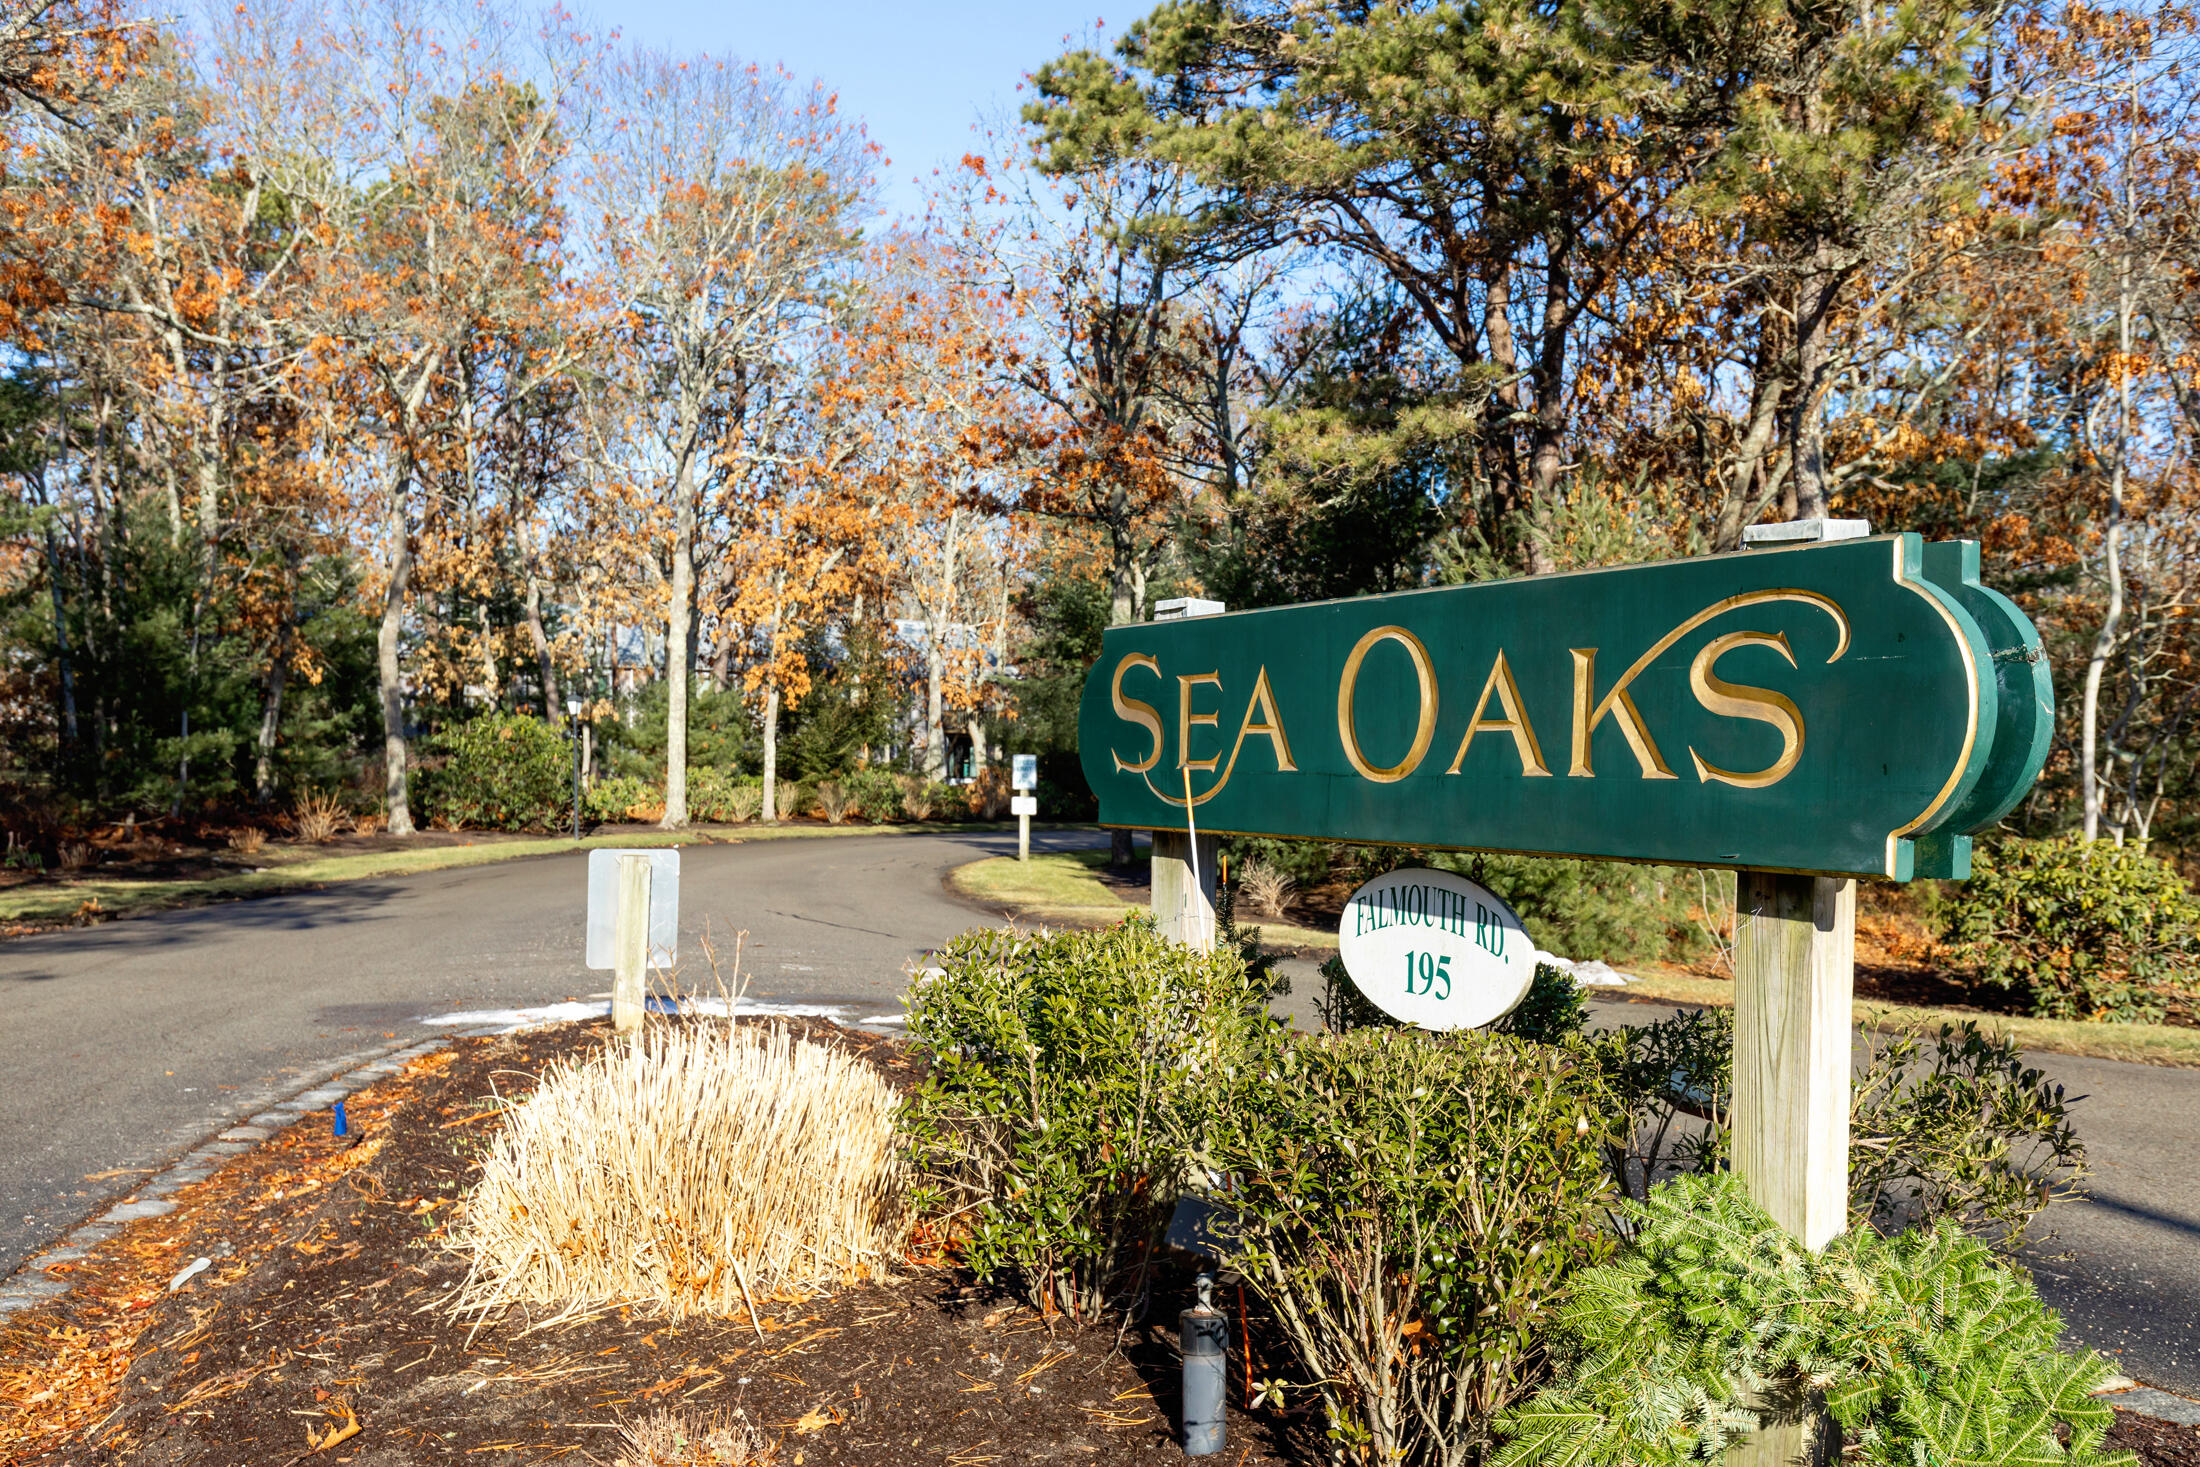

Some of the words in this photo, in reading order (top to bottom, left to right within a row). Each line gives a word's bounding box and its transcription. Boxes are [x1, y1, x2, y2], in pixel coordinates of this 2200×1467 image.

[1111, 652, 1298, 807] SEA
[1338, 588, 1851, 789] OAKS
[1356, 884, 1466, 938] FALMOUTH
[1475, 901, 1508, 964] RD.
[1404, 950, 1451, 1000] 195
